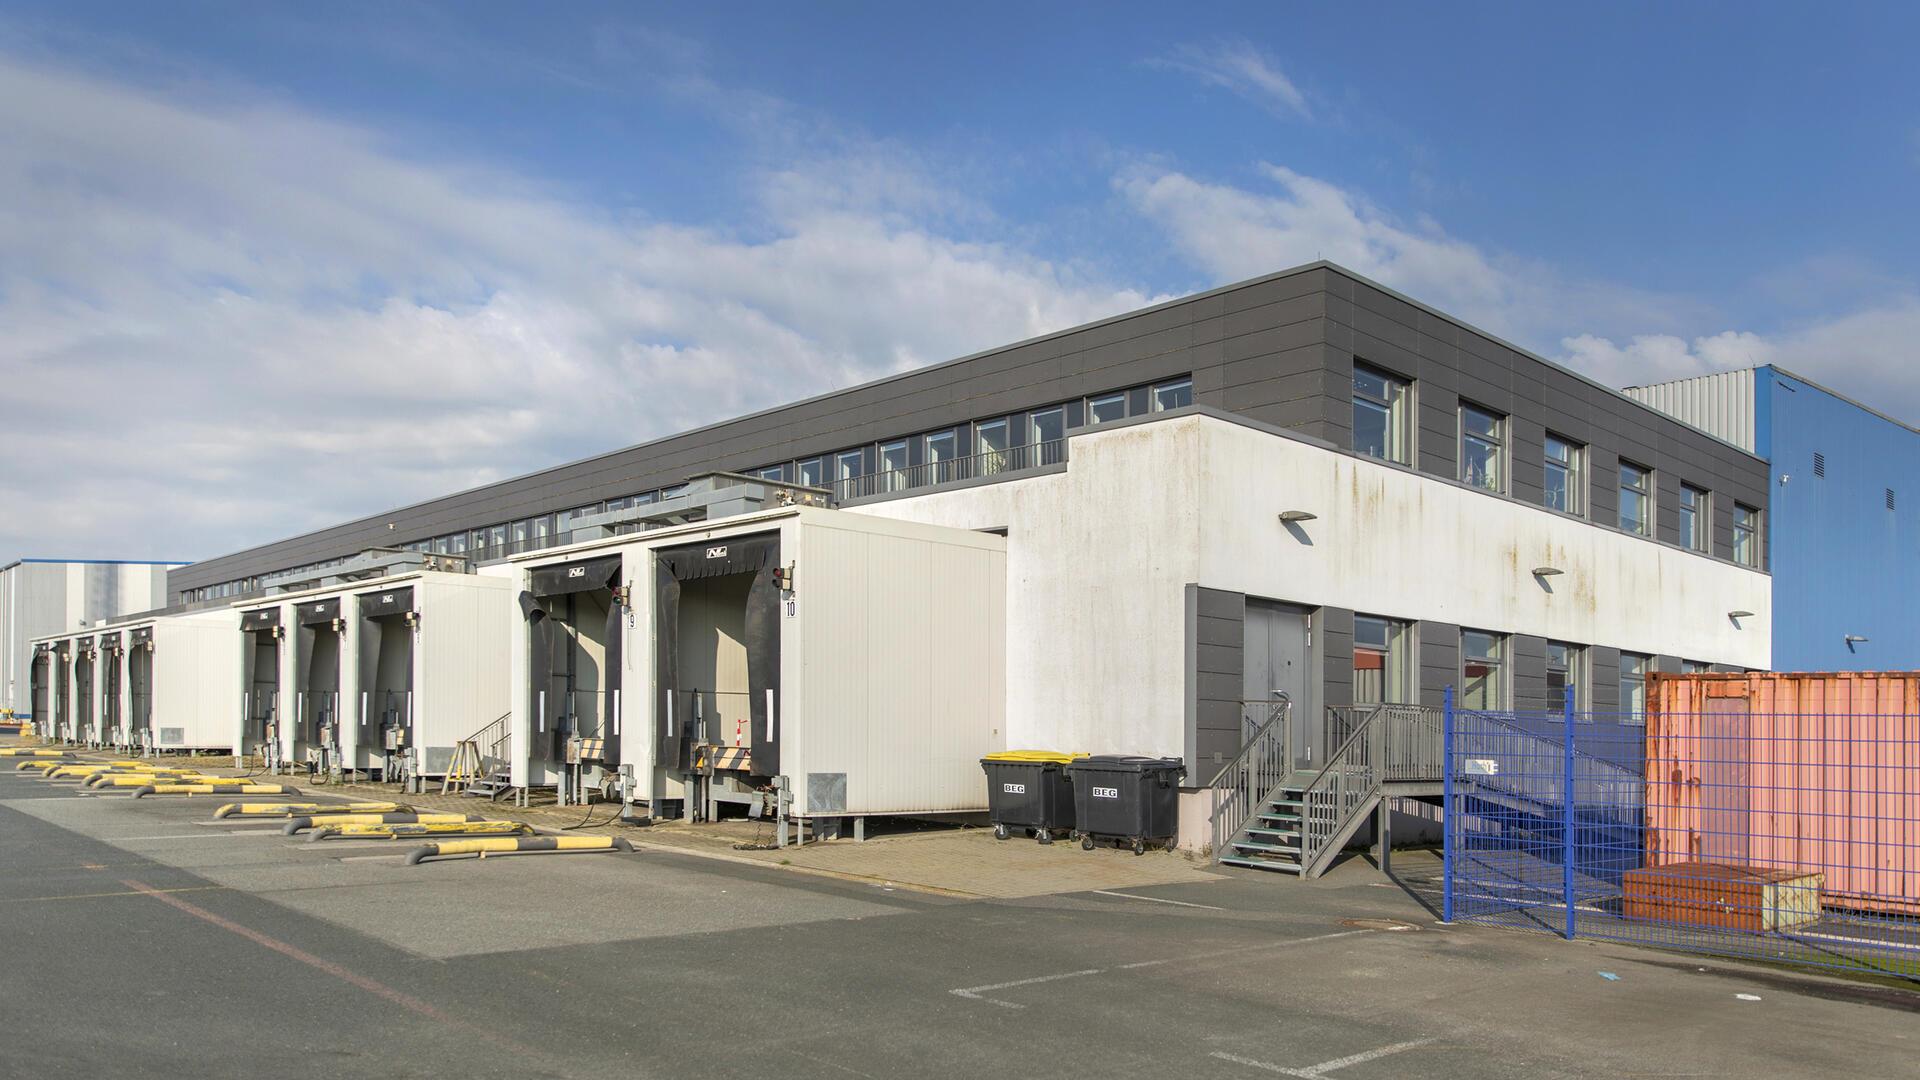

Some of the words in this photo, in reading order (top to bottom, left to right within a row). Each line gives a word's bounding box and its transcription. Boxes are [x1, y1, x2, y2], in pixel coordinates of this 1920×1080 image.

[787, 601, 796, 617] 10
[629, 614, 635, 628] 9
[1005, 784, 1024, 793] BEG
[1094, 788, 1117, 797] BEG
